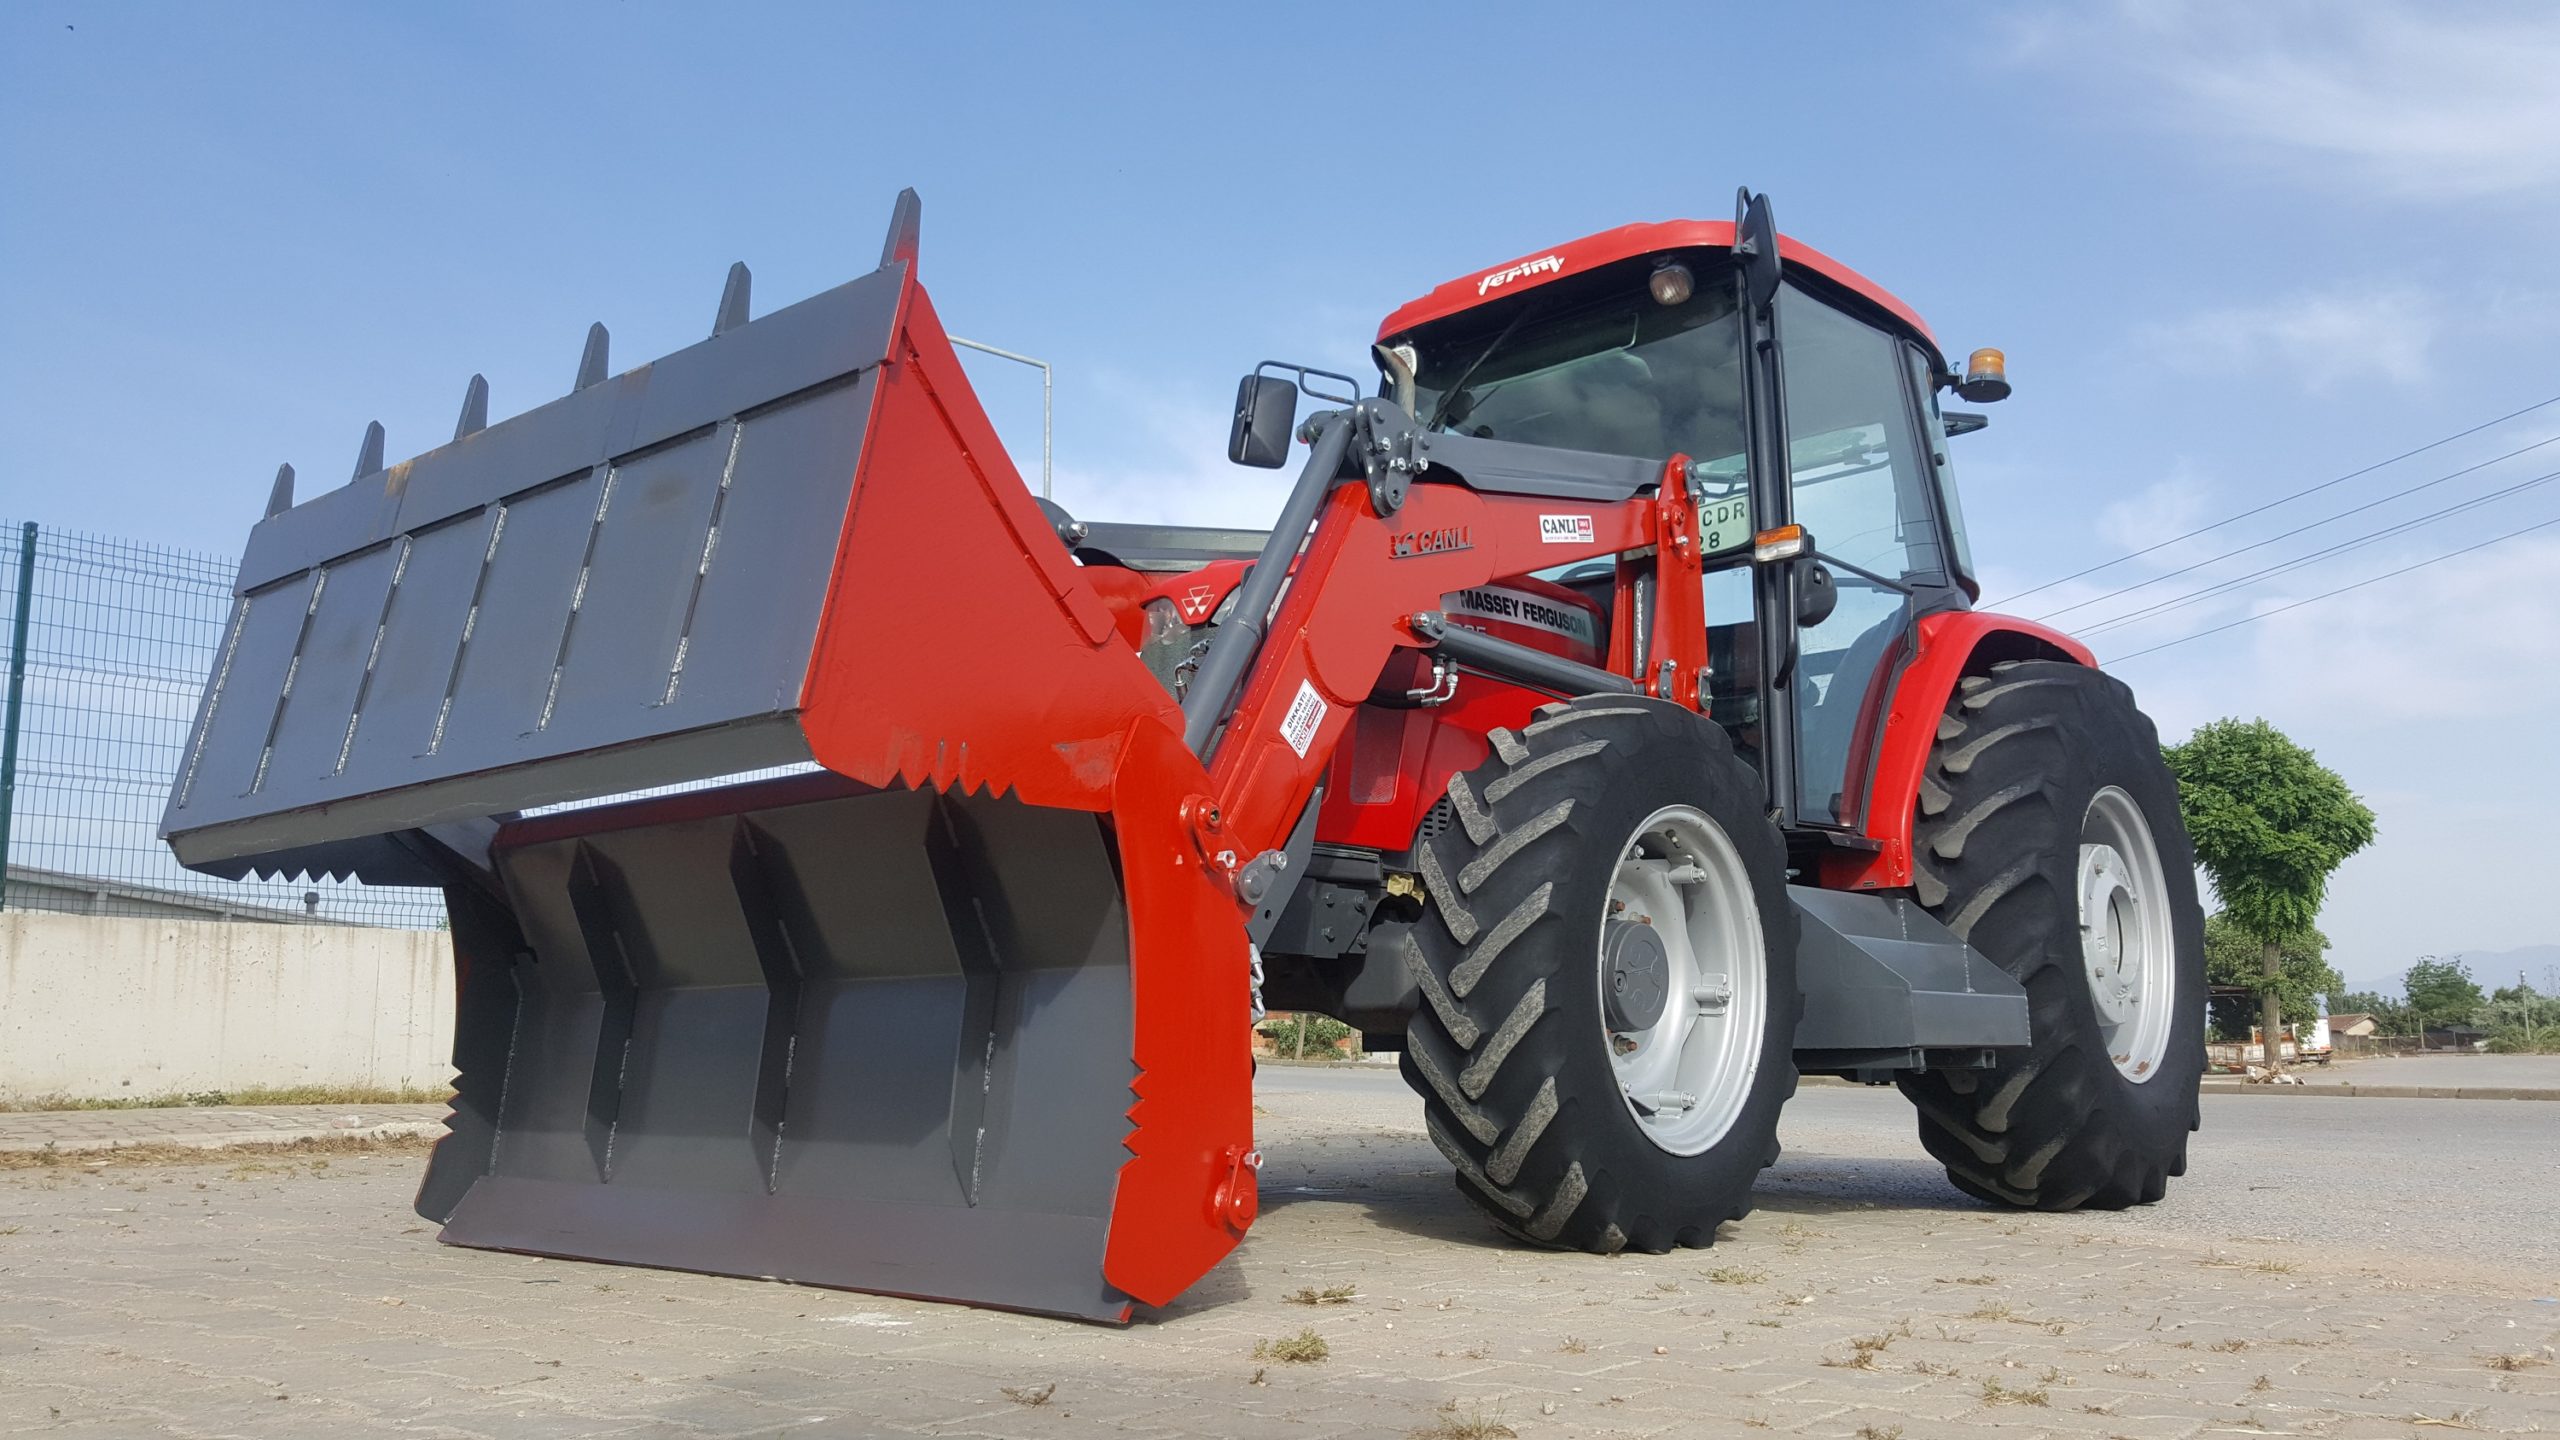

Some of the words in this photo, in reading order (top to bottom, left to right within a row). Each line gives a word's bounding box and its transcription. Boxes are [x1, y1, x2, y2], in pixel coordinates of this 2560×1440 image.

[1543, 518, 1577, 534] CANLI
[1702, 502, 1745, 527] CDR
[1417, 526, 1473, 553] CANLI
[1459, 590, 1519, 617] MASSEY
[1522, 601, 1588, 637] FERGUSON
